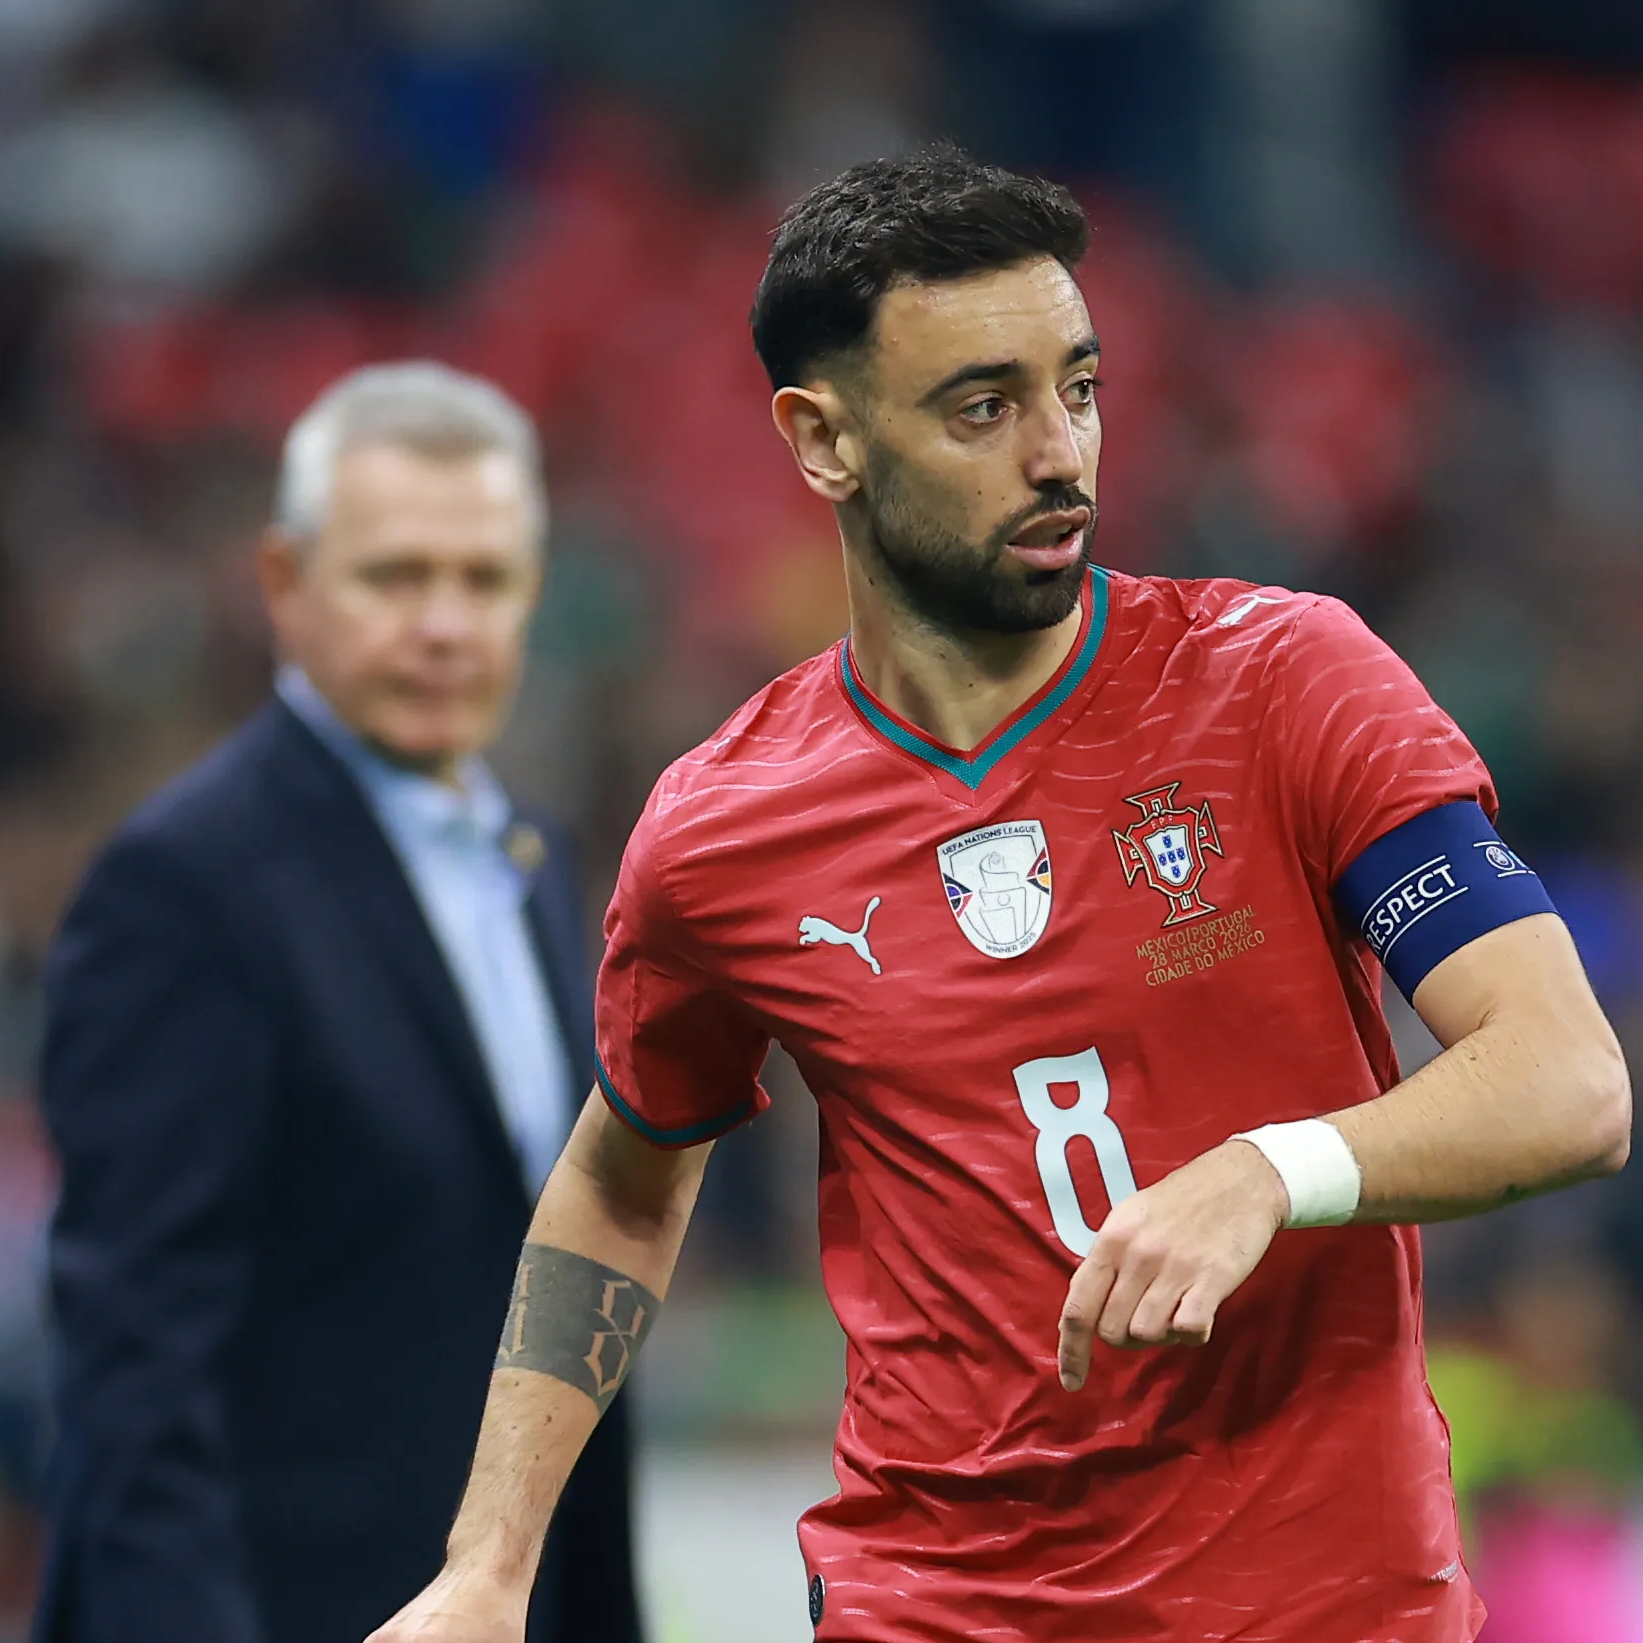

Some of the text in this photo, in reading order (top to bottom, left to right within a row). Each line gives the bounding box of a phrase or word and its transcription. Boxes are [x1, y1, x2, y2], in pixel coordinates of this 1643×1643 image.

[942, 825, 1037, 855] UEFA NATIONS LEAGUE
[1367, 863, 1457, 953] RESPECT
[985, 944, 1019, 953] WINNER
[1149, 953, 1168, 970] 28
[1220, 922, 1252, 945] 2026
[1145, 960, 1194, 987] CIDADE
[1195, 952, 1214, 971] DO
[1012, 1046, 1138, 1258] 8
